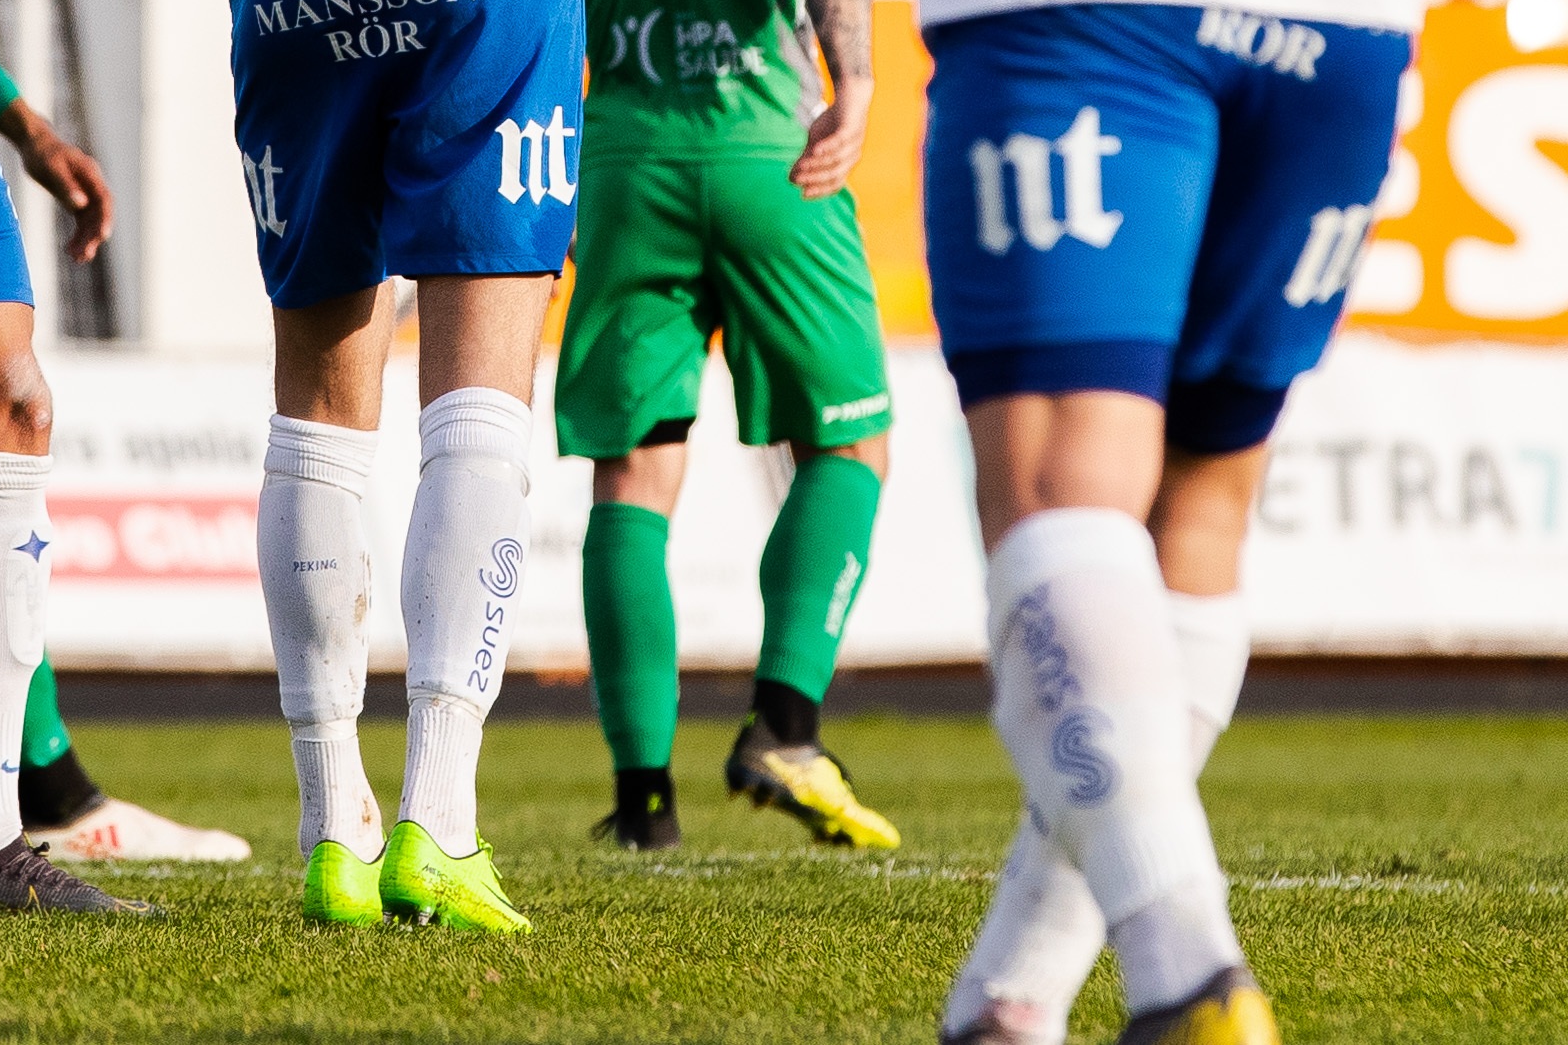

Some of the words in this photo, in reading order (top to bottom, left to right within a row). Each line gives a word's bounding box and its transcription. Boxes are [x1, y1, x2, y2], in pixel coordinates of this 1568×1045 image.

[324, 16, 426, 62] RÖR
[293, 558, 338, 573] PEKING
[466, 601, 504, 693] suez
